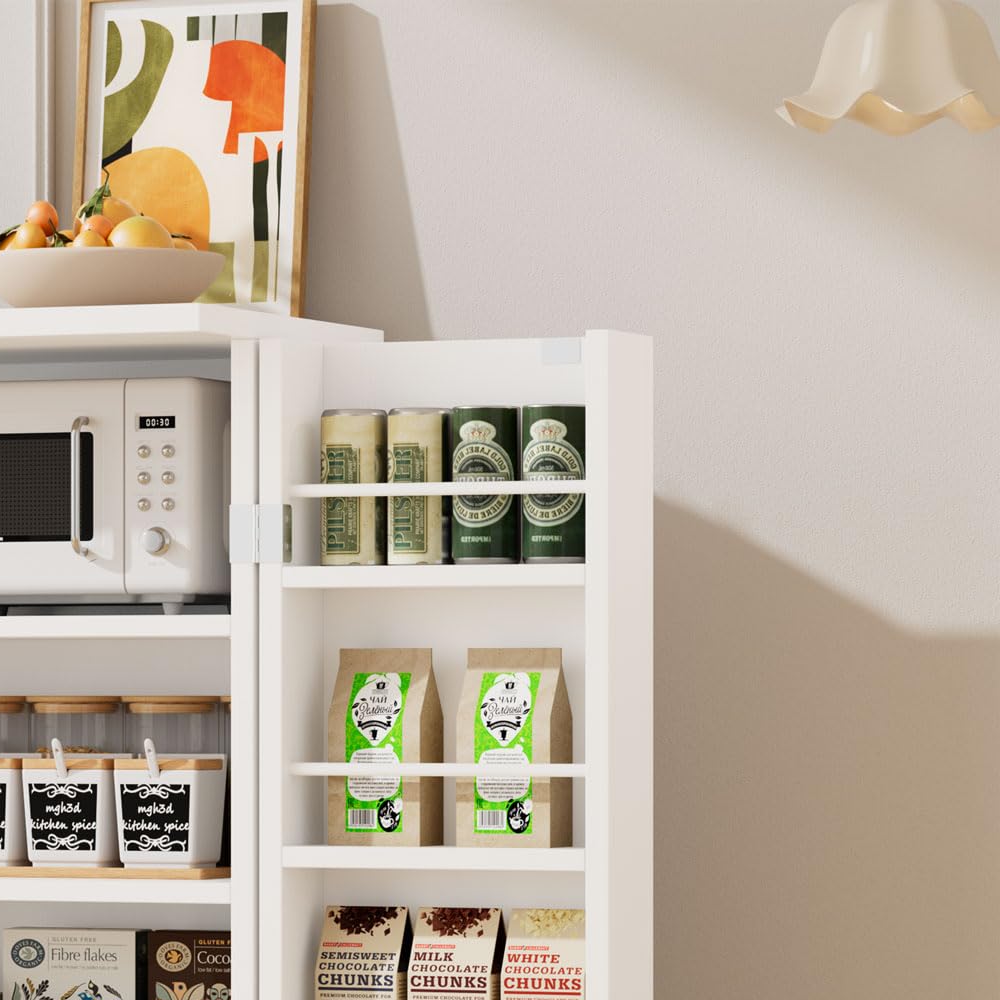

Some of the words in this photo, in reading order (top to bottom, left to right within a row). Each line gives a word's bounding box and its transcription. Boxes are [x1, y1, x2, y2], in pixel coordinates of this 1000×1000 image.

[145, 418, 170, 427] 00:30
[327, 450, 345, 549] PILSER
[394, 449, 412, 549] PILSER
[499, 696, 517, 704] ЧАЙ
[45, 800, 81, 815] mgh3d
[137, 801, 174, 816] mgh3d
[31, 818, 67, 830] kitchen
[71, 819, 97, 832] spice
[122, 819, 160, 831] kitchen
[164, 820, 190, 833] spice
[51, 947, 80, 961] Fibre
[83, 947, 118, 962] flakes
[197, 950, 231, 964] Coco
[320, 951, 397, 961] SEMISWEET
[413, 951, 454, 962] MILK
[507, 953, 561, 964] WHITE
[319, 962, 395, 972] CHOCOLATE
[411, 963, 488, 974] CHOCOLATE
[505, 965, 583, 976] CHOCOLATE
[318, 973, 394, 986] CHUNKS
[410, 975, 487, 988] CHUNKS
[503, 977, 582, 991] CHUNKS
